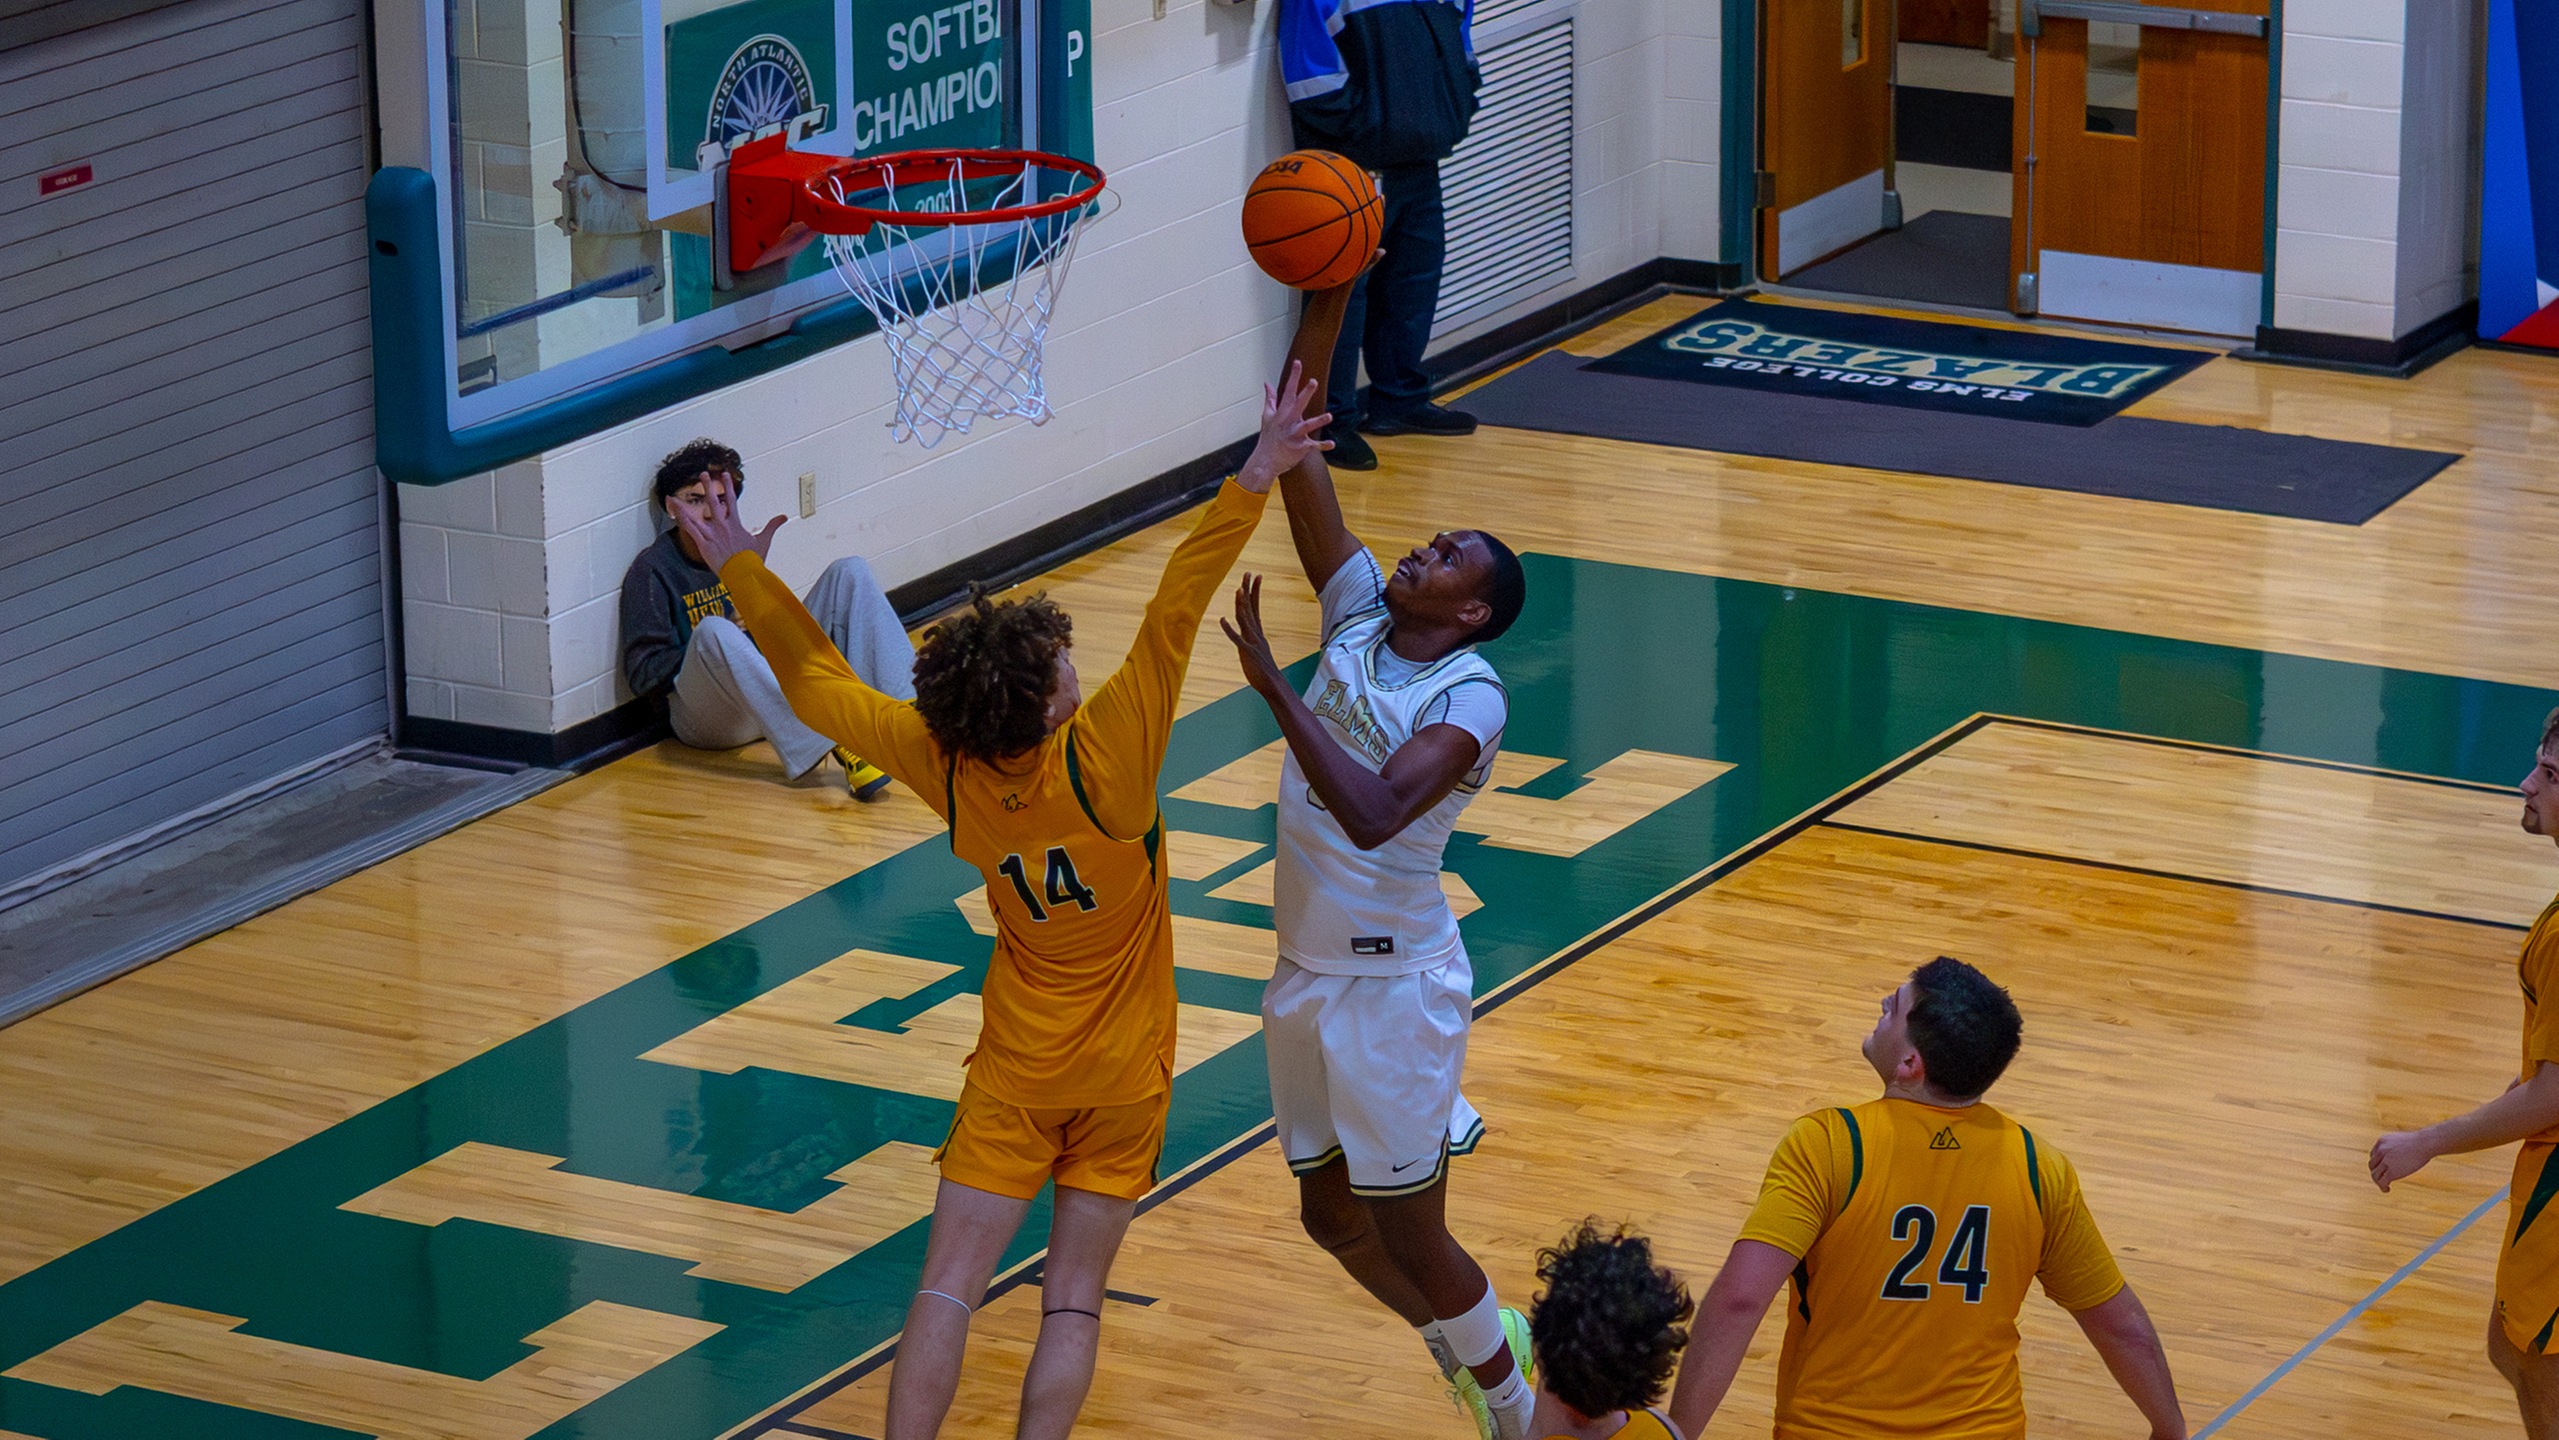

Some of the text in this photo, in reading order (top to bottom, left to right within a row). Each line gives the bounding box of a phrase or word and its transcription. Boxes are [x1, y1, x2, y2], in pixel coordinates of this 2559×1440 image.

[886, 0, 1001, 71] SOFTB
[712, 44, 809, 129] NORTH ATLANTIC
[853, 58, 1002, 151] CHAMPIO
[1664, 318, 2167, 399] BLAZERS
[1703, 356, 2034, 402] ELMS COLLEGE
[1312, 679, 1391, 765] ELMS
[997, 845, 1099, 923] 14
[1879, 1203, 1991, 1304] 24
